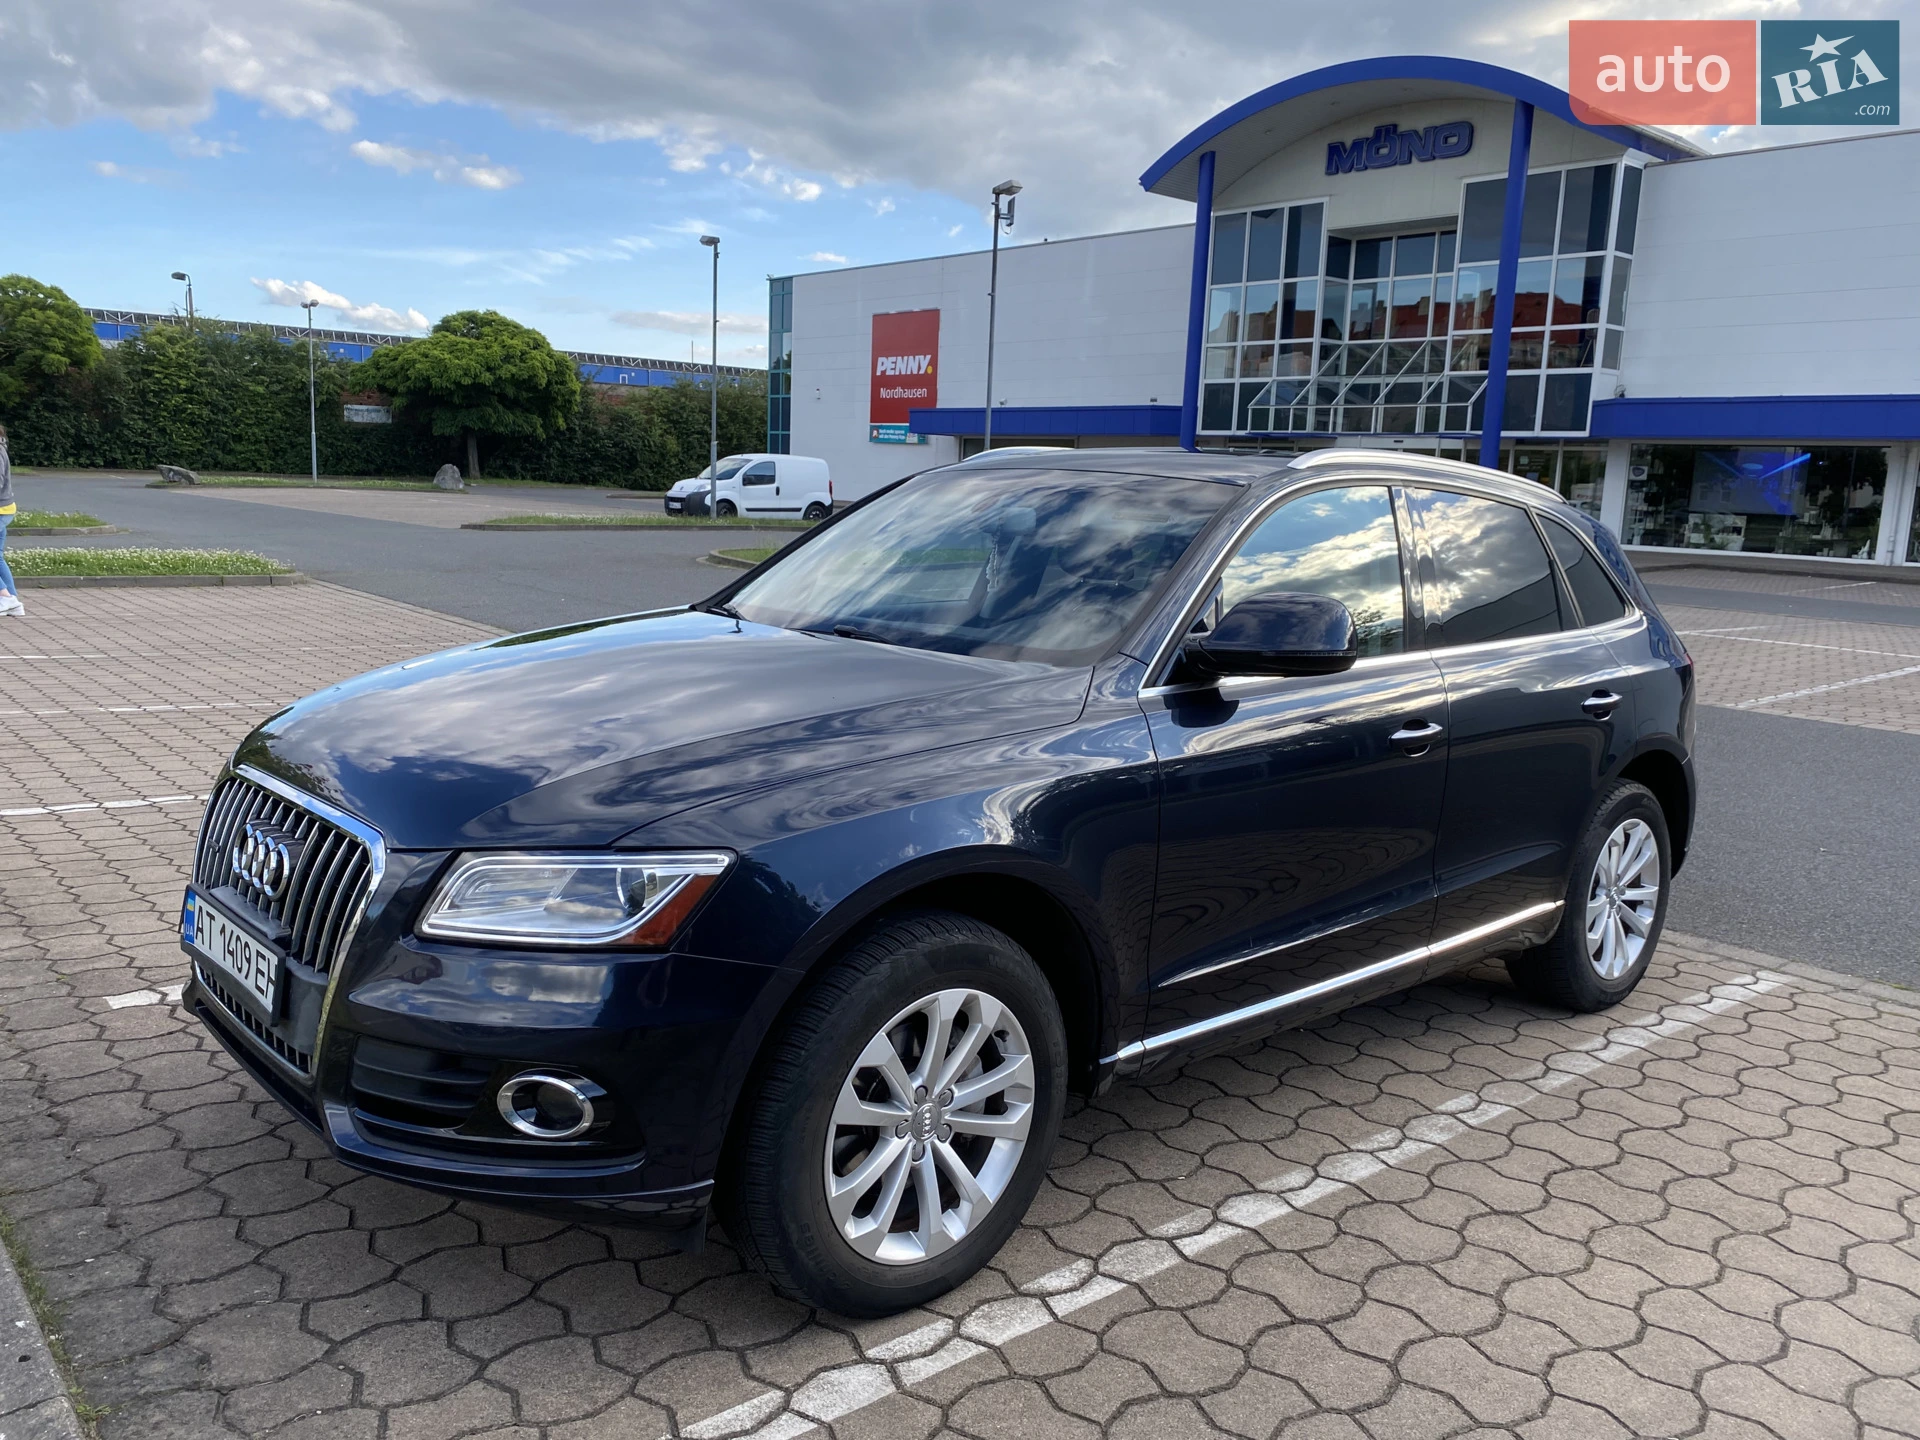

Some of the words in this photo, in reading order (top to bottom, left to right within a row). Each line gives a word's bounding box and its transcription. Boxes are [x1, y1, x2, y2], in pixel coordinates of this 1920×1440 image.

[1325, 121, 1474, 175] MÖNO
[880, 386, 928, 399] Nordhausen
[185, 922, 194, 937] UA
[195, 905, 216, 951] AT
[219, 923, 252, 980] 1409
